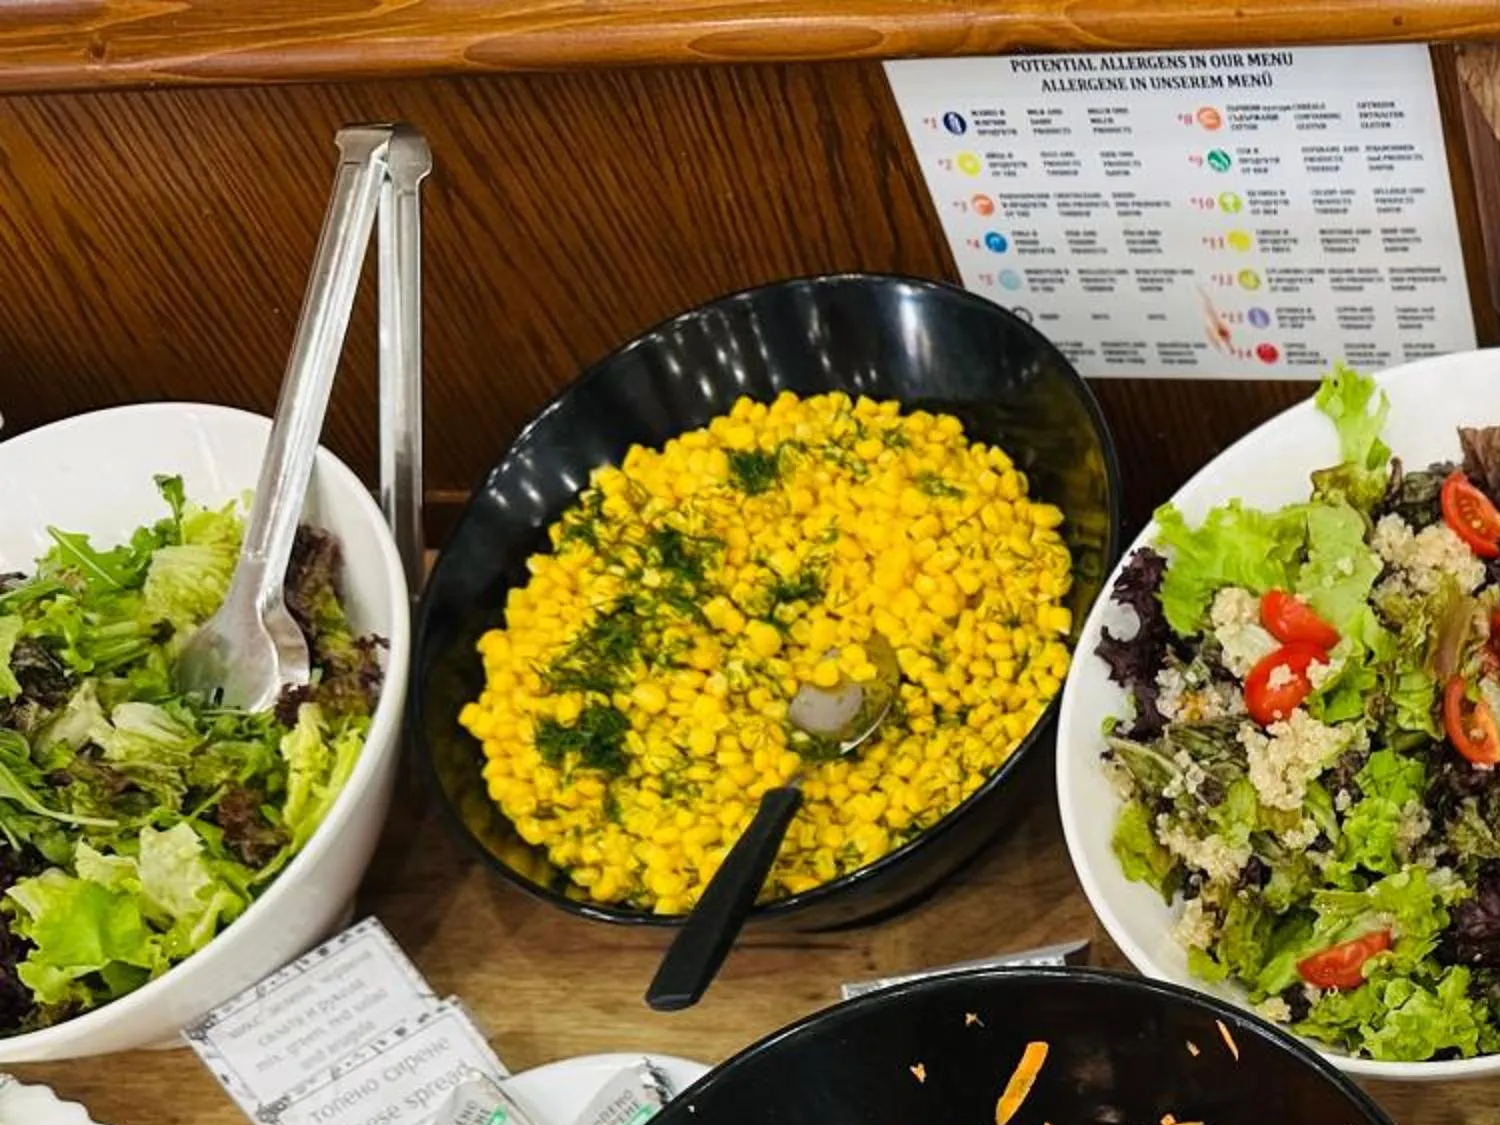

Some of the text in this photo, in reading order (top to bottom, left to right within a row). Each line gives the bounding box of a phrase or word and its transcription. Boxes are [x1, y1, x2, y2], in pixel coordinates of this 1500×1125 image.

[1010, 51, 1293, 73] POTENTIAL ALLERGENS IN OUR MENU
[1042, 71, 1273, 92] ALLERGENE IN UNSEREM MENÜ
[309, 1077, 380, 1125] топено
[404, 1059, 471, 1109] spread
